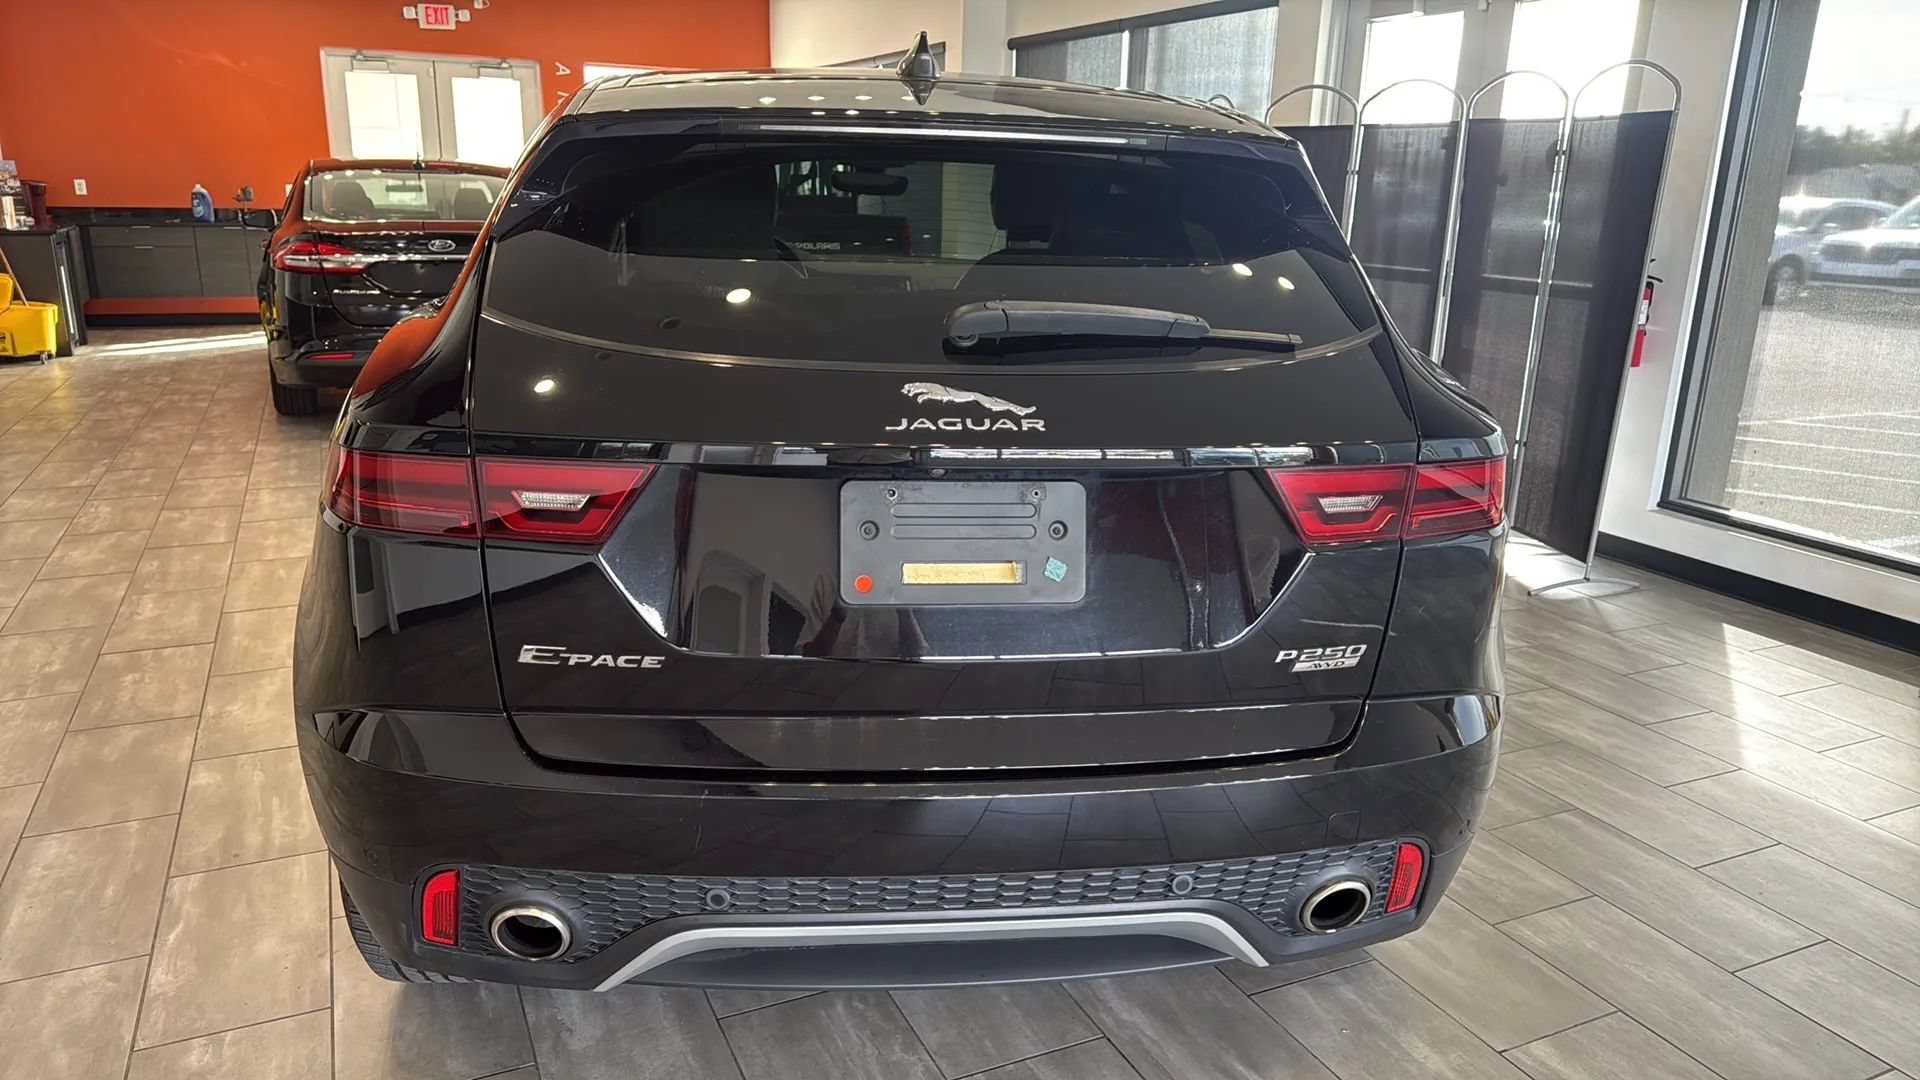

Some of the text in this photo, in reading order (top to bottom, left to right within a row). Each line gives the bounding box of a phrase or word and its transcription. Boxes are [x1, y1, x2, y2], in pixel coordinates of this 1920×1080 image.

[425, 6, 449, 25] EXIT
[885, 418, 1046, 431] JAGUAR
[1274, 644, 1368, 663] P250
[1308, 660, 1345, 669] AWD
